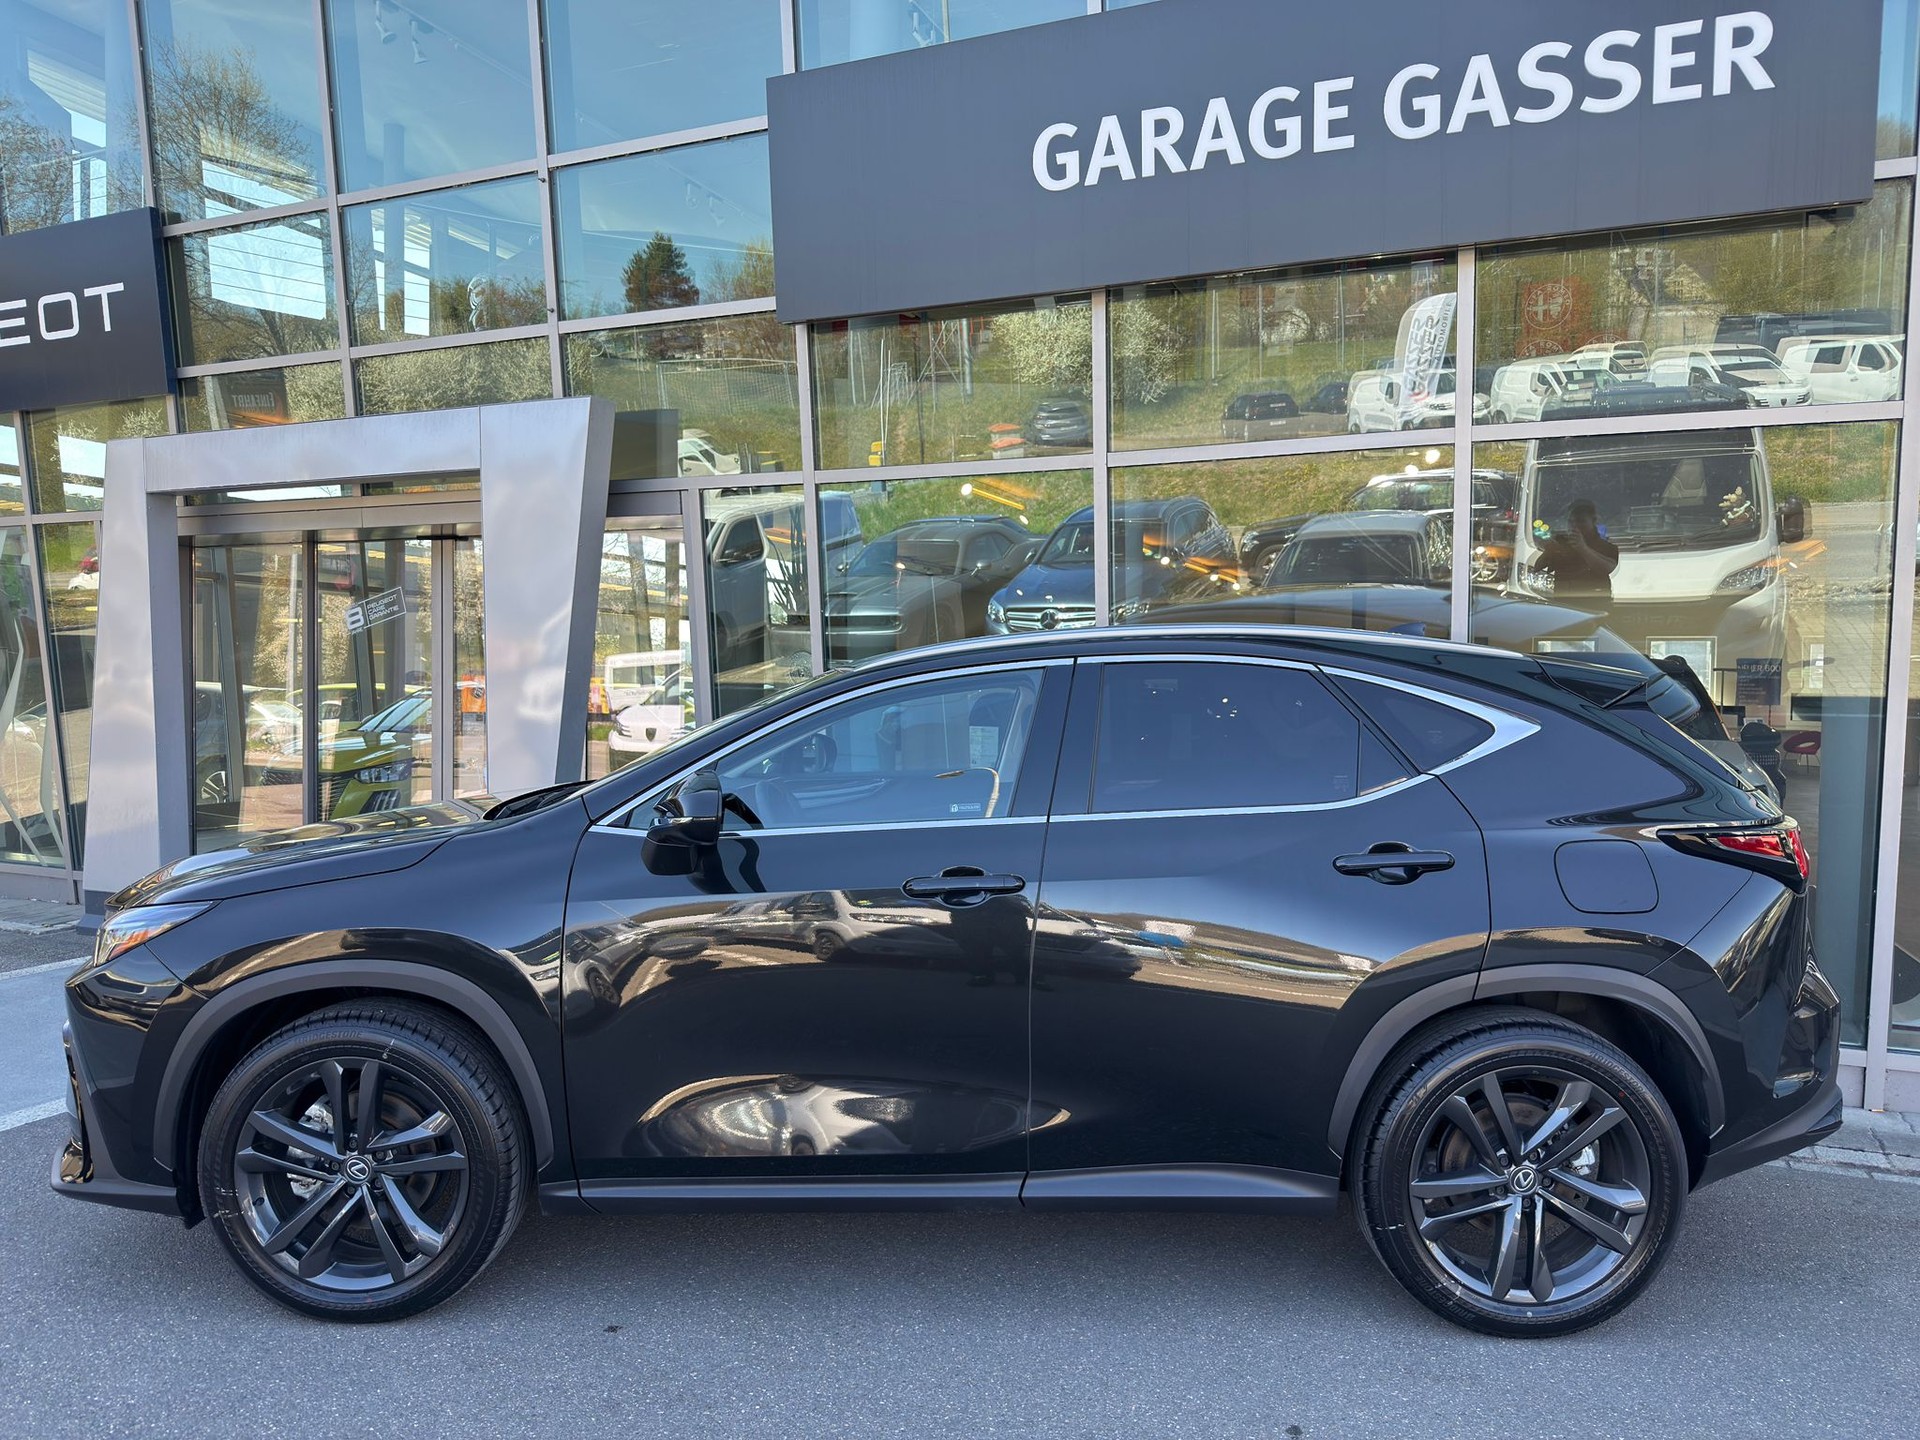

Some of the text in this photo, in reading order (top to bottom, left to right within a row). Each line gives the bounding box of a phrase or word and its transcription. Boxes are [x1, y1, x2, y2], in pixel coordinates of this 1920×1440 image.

[1032, 11, 1776, 192] GARAGE GASSER
[0, 282, 125, 347] EOT
[367, 594, 398, 609] PEUGEOT
[367, 604, 386, 615] CARE
